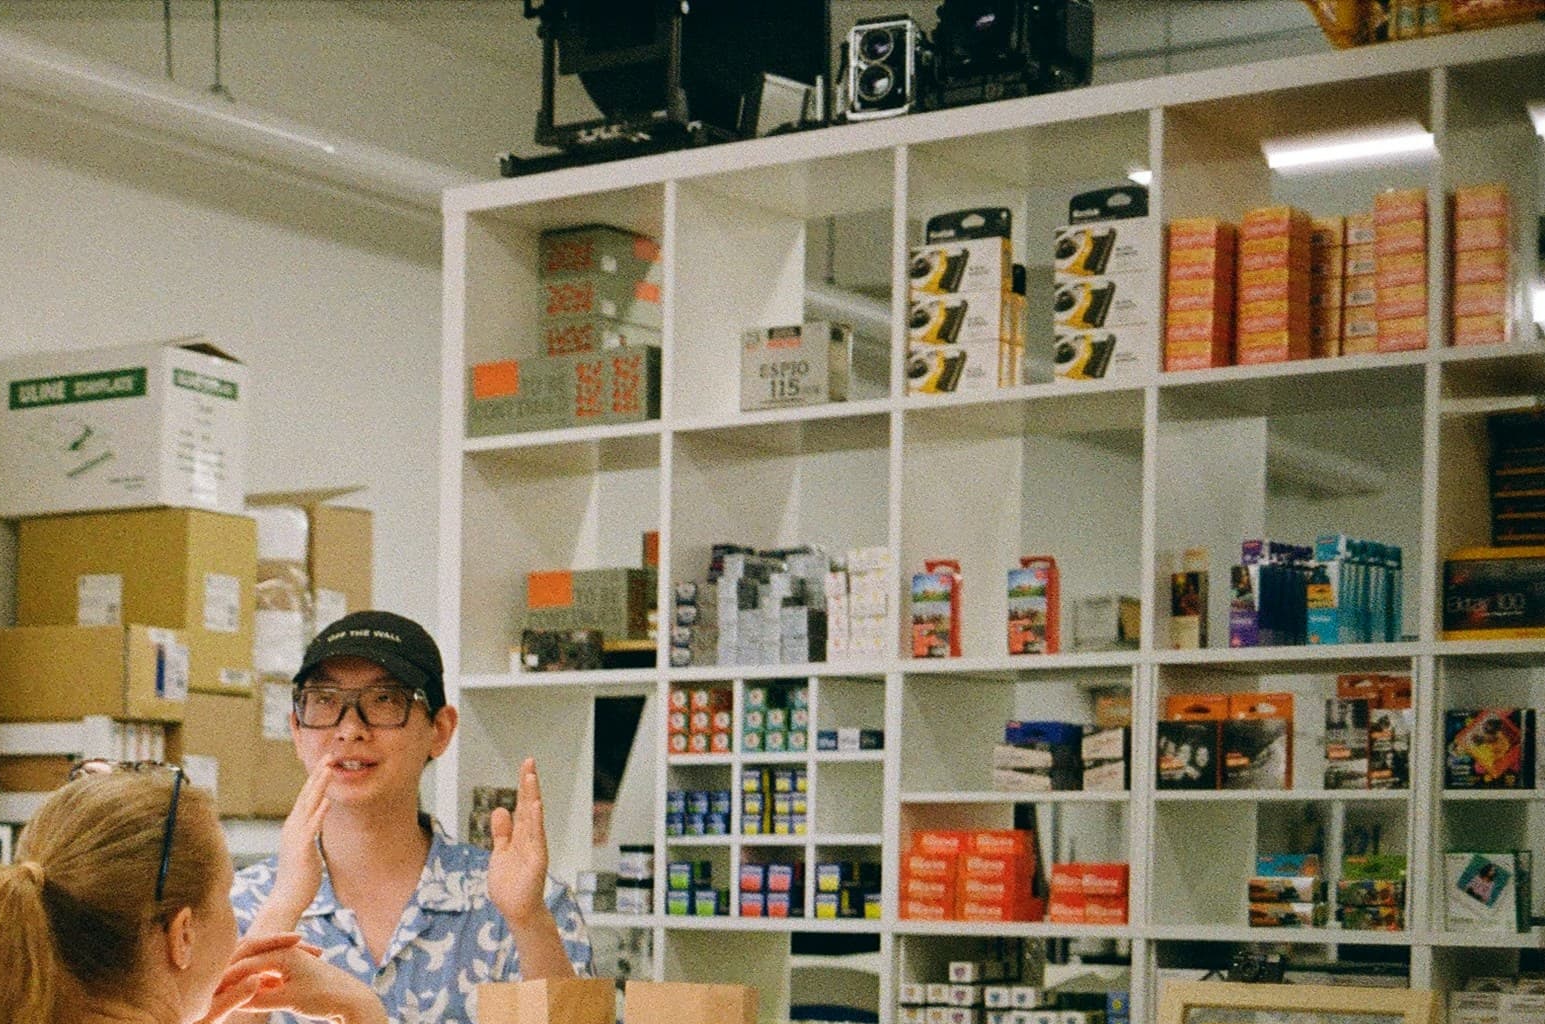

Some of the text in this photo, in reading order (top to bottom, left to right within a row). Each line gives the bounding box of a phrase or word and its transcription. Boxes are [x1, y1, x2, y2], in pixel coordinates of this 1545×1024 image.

[770, 379, 800, 398] 115
[350, 629, 370, 638] THE
[373, 630, 402, 642] WALL
